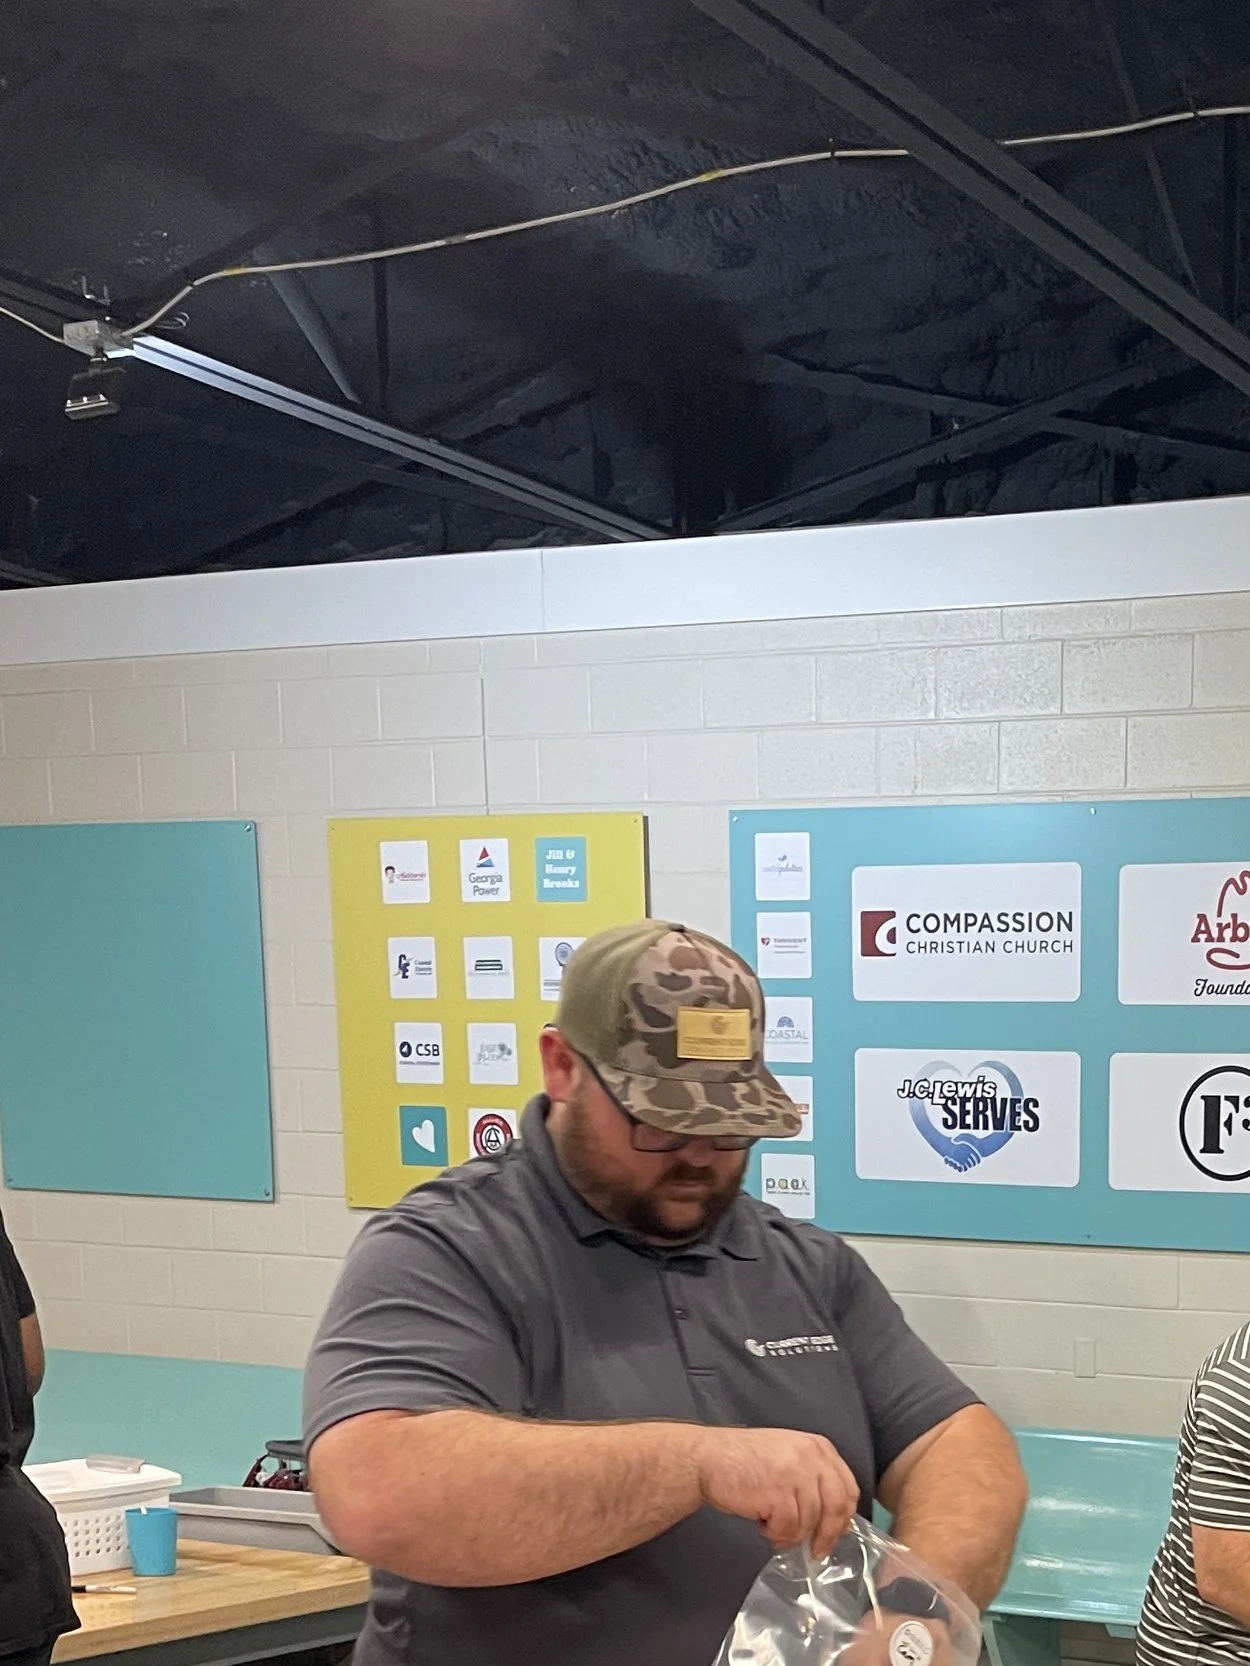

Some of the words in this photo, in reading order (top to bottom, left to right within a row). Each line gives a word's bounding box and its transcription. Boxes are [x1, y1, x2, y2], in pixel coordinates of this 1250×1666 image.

[545, 864, 576, 876] Henry
[469, 873, 503, 885] Georgia
[473, 885, 499, 896] Power
[906, 912, 1073, 934] COMPASSION
[906, 940, 995, 954] CHRISTIAN
[1003, 940, 1073, 953] CHURCH
[416, 1044, 439, 1056] CSB
[941, 1097, 1039, 1132] SERVES
